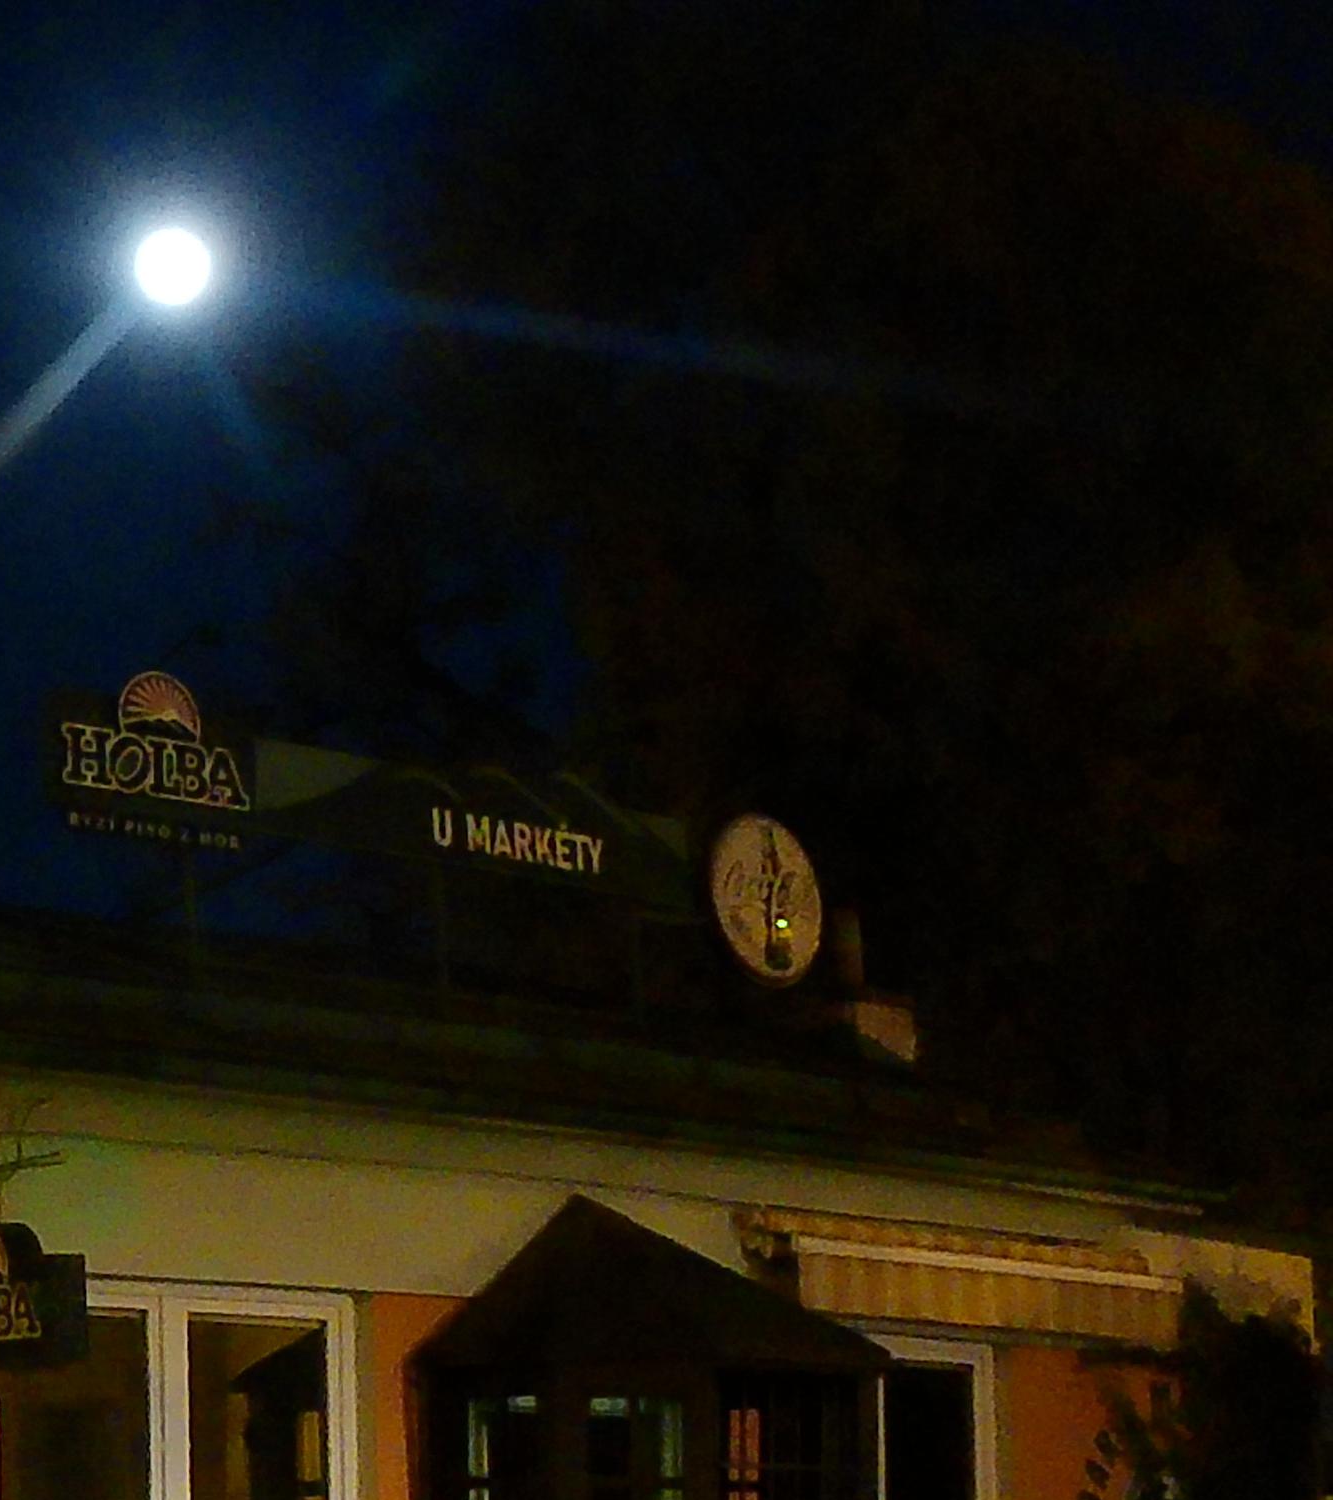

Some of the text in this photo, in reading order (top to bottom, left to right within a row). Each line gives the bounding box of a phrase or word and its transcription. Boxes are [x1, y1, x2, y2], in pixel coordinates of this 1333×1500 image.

[62, 722, 251, 812] HOLBA
[432, 806, 603, 875] U MARKÉTY
